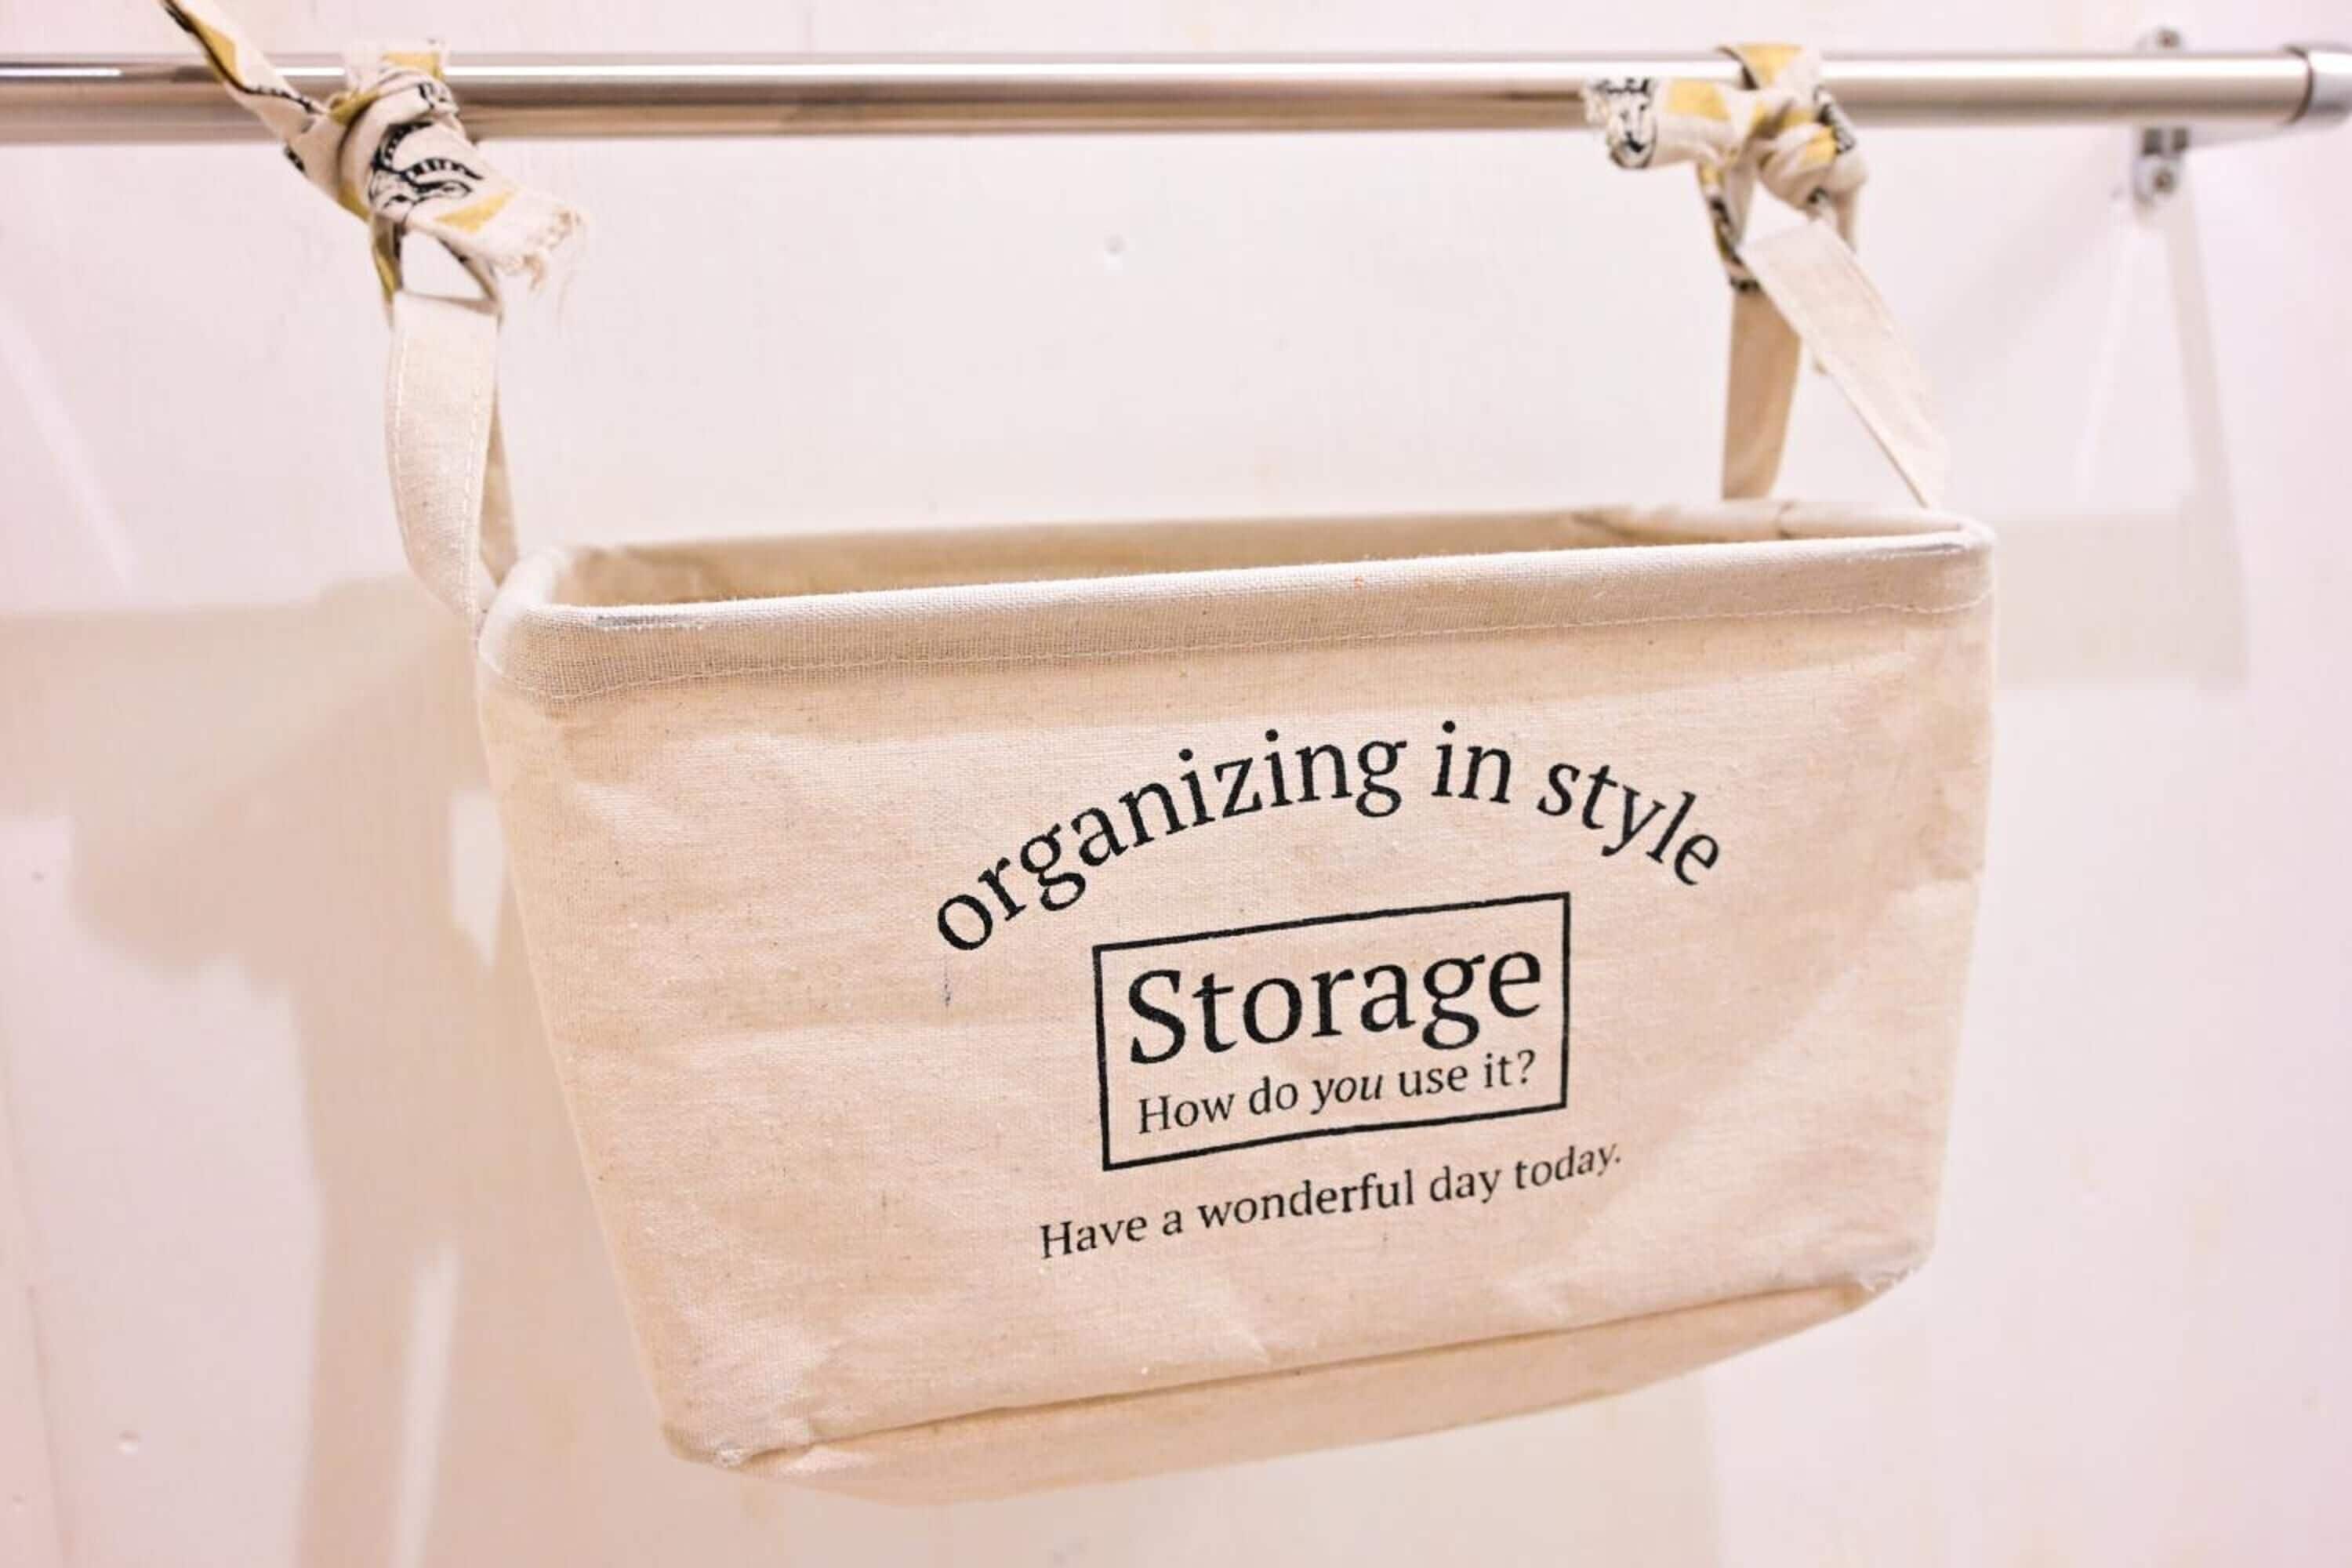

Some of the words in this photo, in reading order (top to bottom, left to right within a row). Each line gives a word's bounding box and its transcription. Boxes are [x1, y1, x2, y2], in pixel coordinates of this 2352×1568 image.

[936, 728, 1408, 952] organizing
[1431, 720, 1512, 804] in
[1537, 762, 1720, 887] style
[1128, 950, 1541, 1065] Storage
[1138, 1094, 1235, 1134] How
[1249, 1076, 1298, 1116] do
[1310, 1074, 1384, 1116] you
[1399, 1065, 1468, 1098] use
[1483, 1049, 1536, 1088] it?
[1040, 1215, 1148, 1259] Have
[1162, 1210, 1184, 1237] a
[1197, 1168, 1414, 1229] wonderful
[1428, 1166, 1502, 1203] day
[1515, 1142, 1623, 1190] today.
